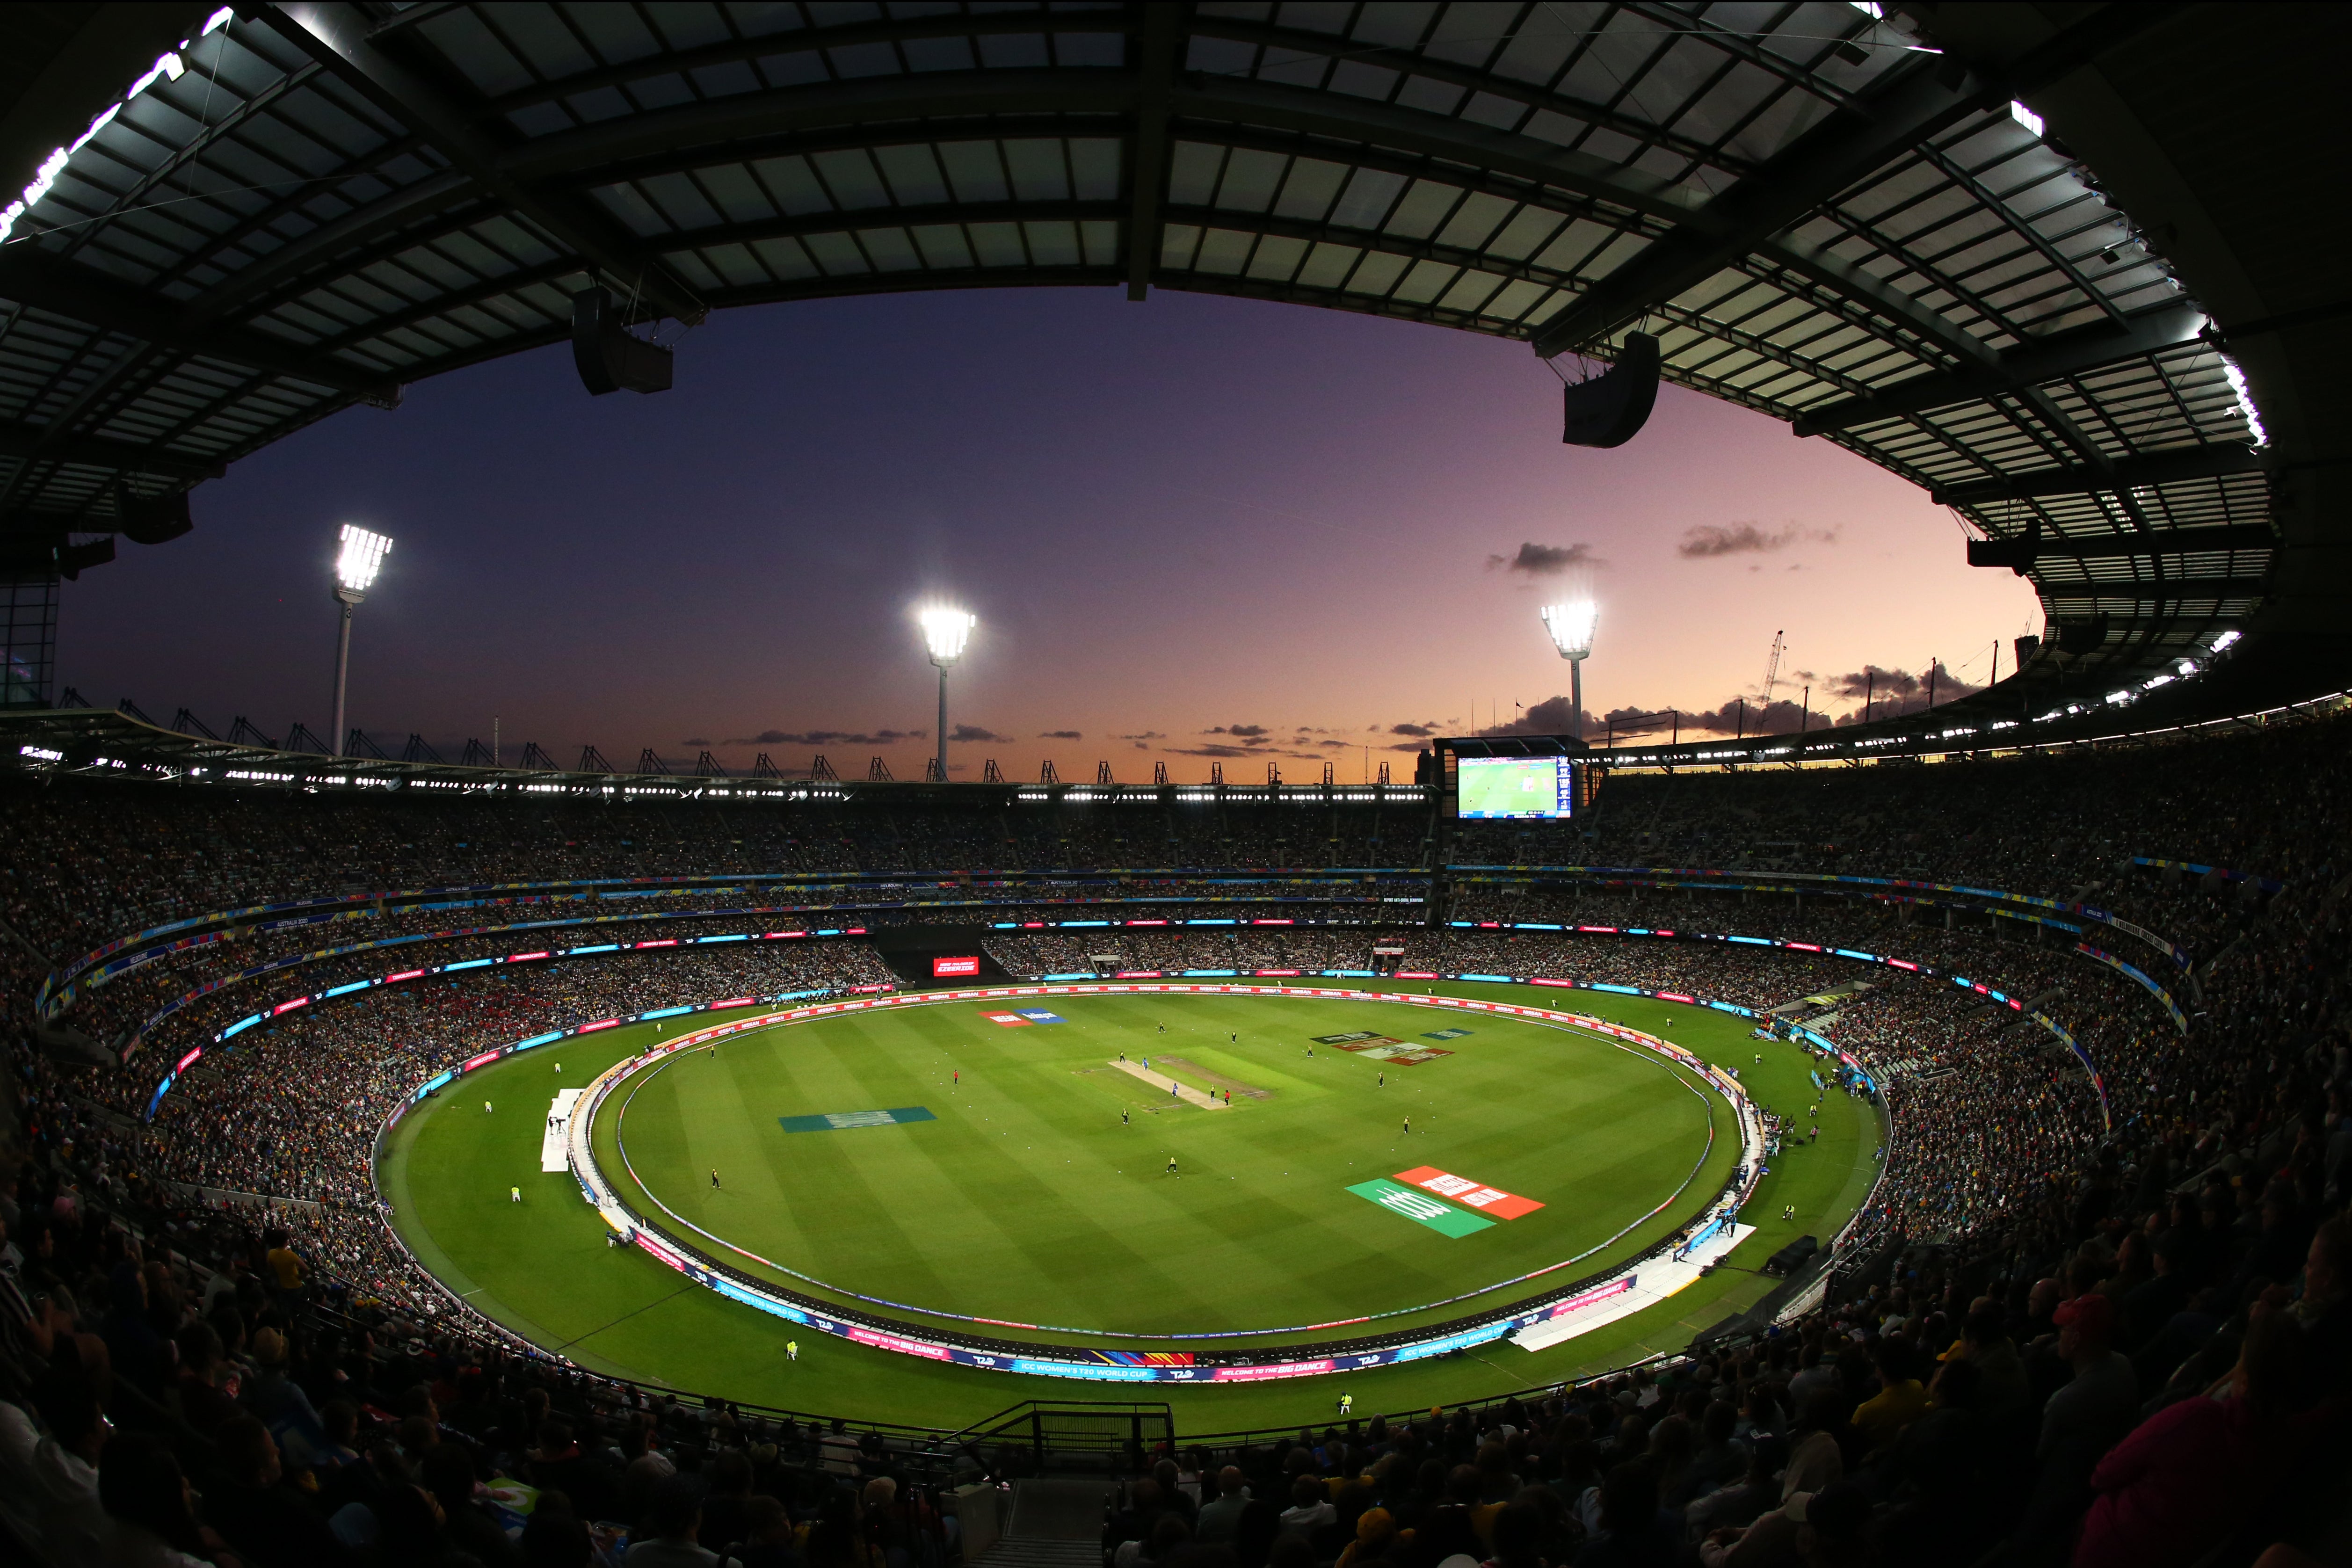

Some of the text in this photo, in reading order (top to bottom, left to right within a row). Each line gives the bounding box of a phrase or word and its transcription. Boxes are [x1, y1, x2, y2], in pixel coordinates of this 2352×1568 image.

[392, 971, 421, 980] T20WORLDCUP.COM
[585, 1020, 616, 1031] T20WORLDCUP.COM
[696, 1033, 711, 1041] NISSAN
[675, 1040, 690, 1049] NISSAN
[1641, 1038, 1655, 1048] NISSAN
[1661, 1046, 1673, 1056] NISSAN
[668, 1254, 682, 1267] DANCE
[1557, 1300, 1577, 1312] WELCOME
[1592, 1290, 1603, 1300] BIG
[1603, 1282, 1623, 1296] DANCE
[729, 1287, 755, 1302] WOMEN'S
[755, 1298, 765, 1307] T20
[766, 1302, 787, 1314] WORLD
[788, 1310, 800, 1319] CUP
[855, 1331, 880, 1341] WELCOME
[915, 1345, 944, 1356] DANCE
[1418, 1342, 1454, 1354] WOMEN'S
[1454, 1337, 1466, 1346] T20
[1468, 1331, 1493, 1343] WORLD
[1494, 1325, 1507, 1335] CUP
[1037, 1364, 1077, 1373] WOMEN'S
[1277, 1365, 1294, 1373] BIG
[1295, 1362, 1328, 1371] DANCE
